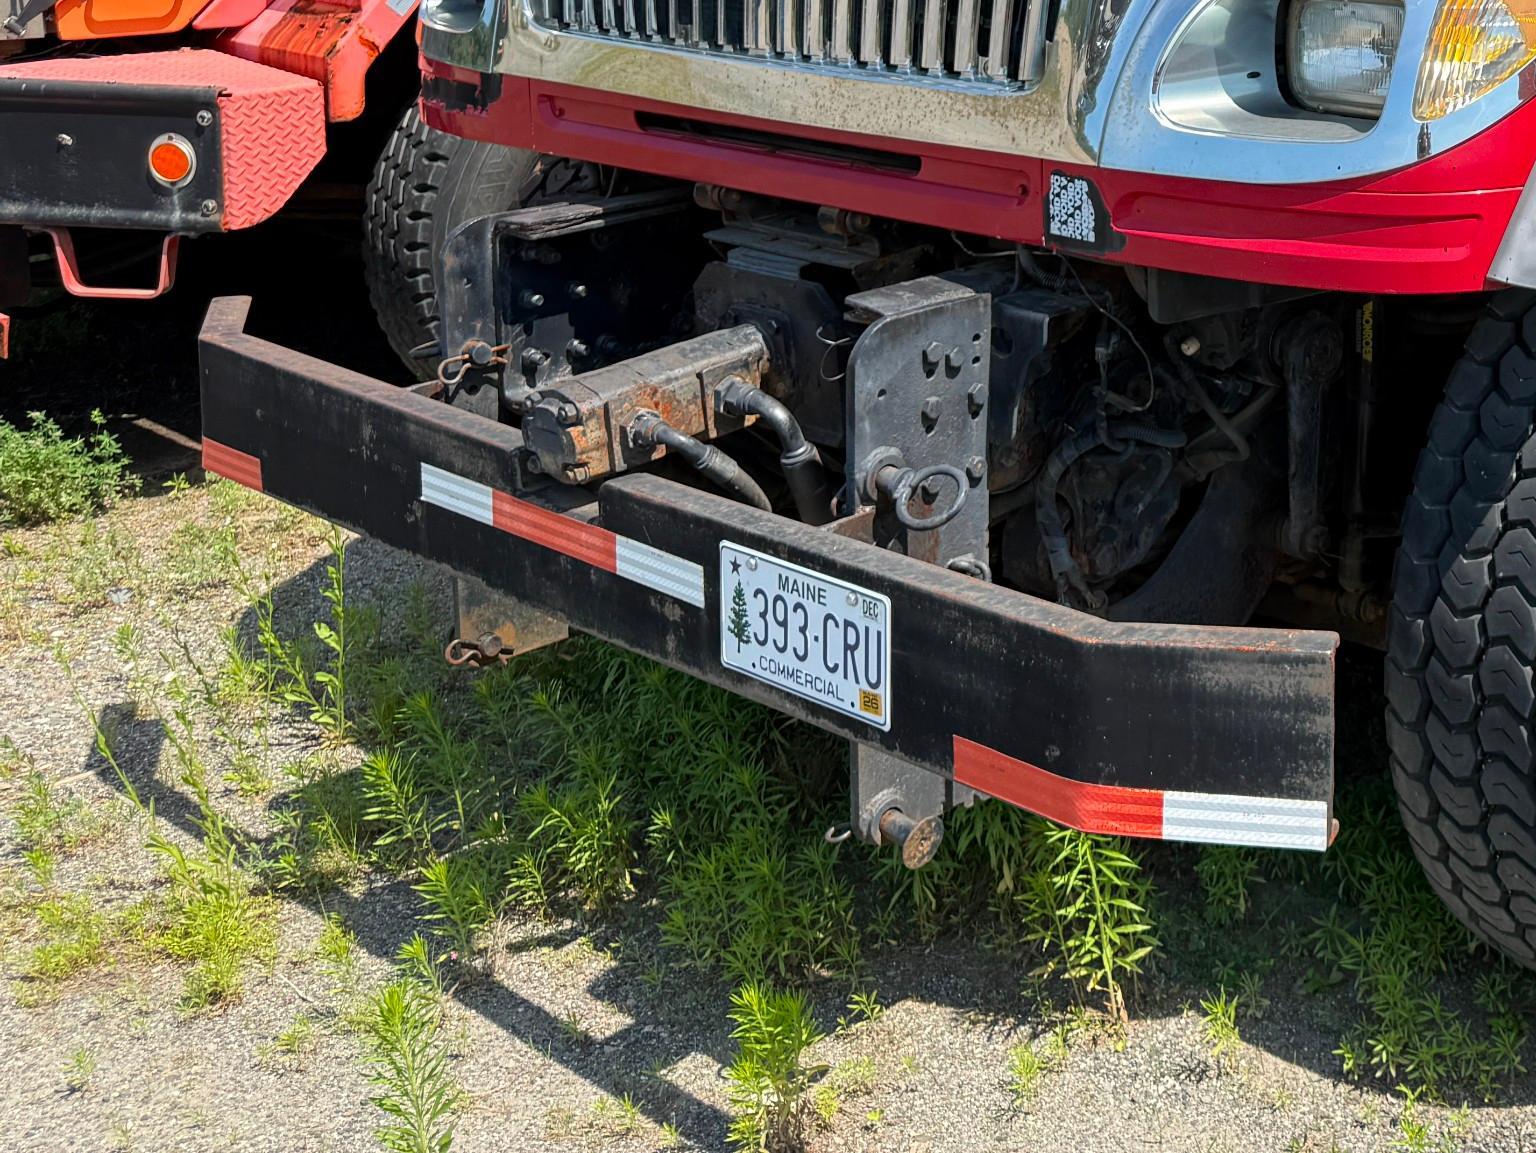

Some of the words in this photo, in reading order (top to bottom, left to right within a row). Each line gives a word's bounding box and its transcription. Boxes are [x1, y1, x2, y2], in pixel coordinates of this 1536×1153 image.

[778, 573, 827, 607] MAINE
[862, 599, 879, 618] DEC
[759, 655, 845, 702] COMMERCIAL
[863, 695, 879, 709] 26
